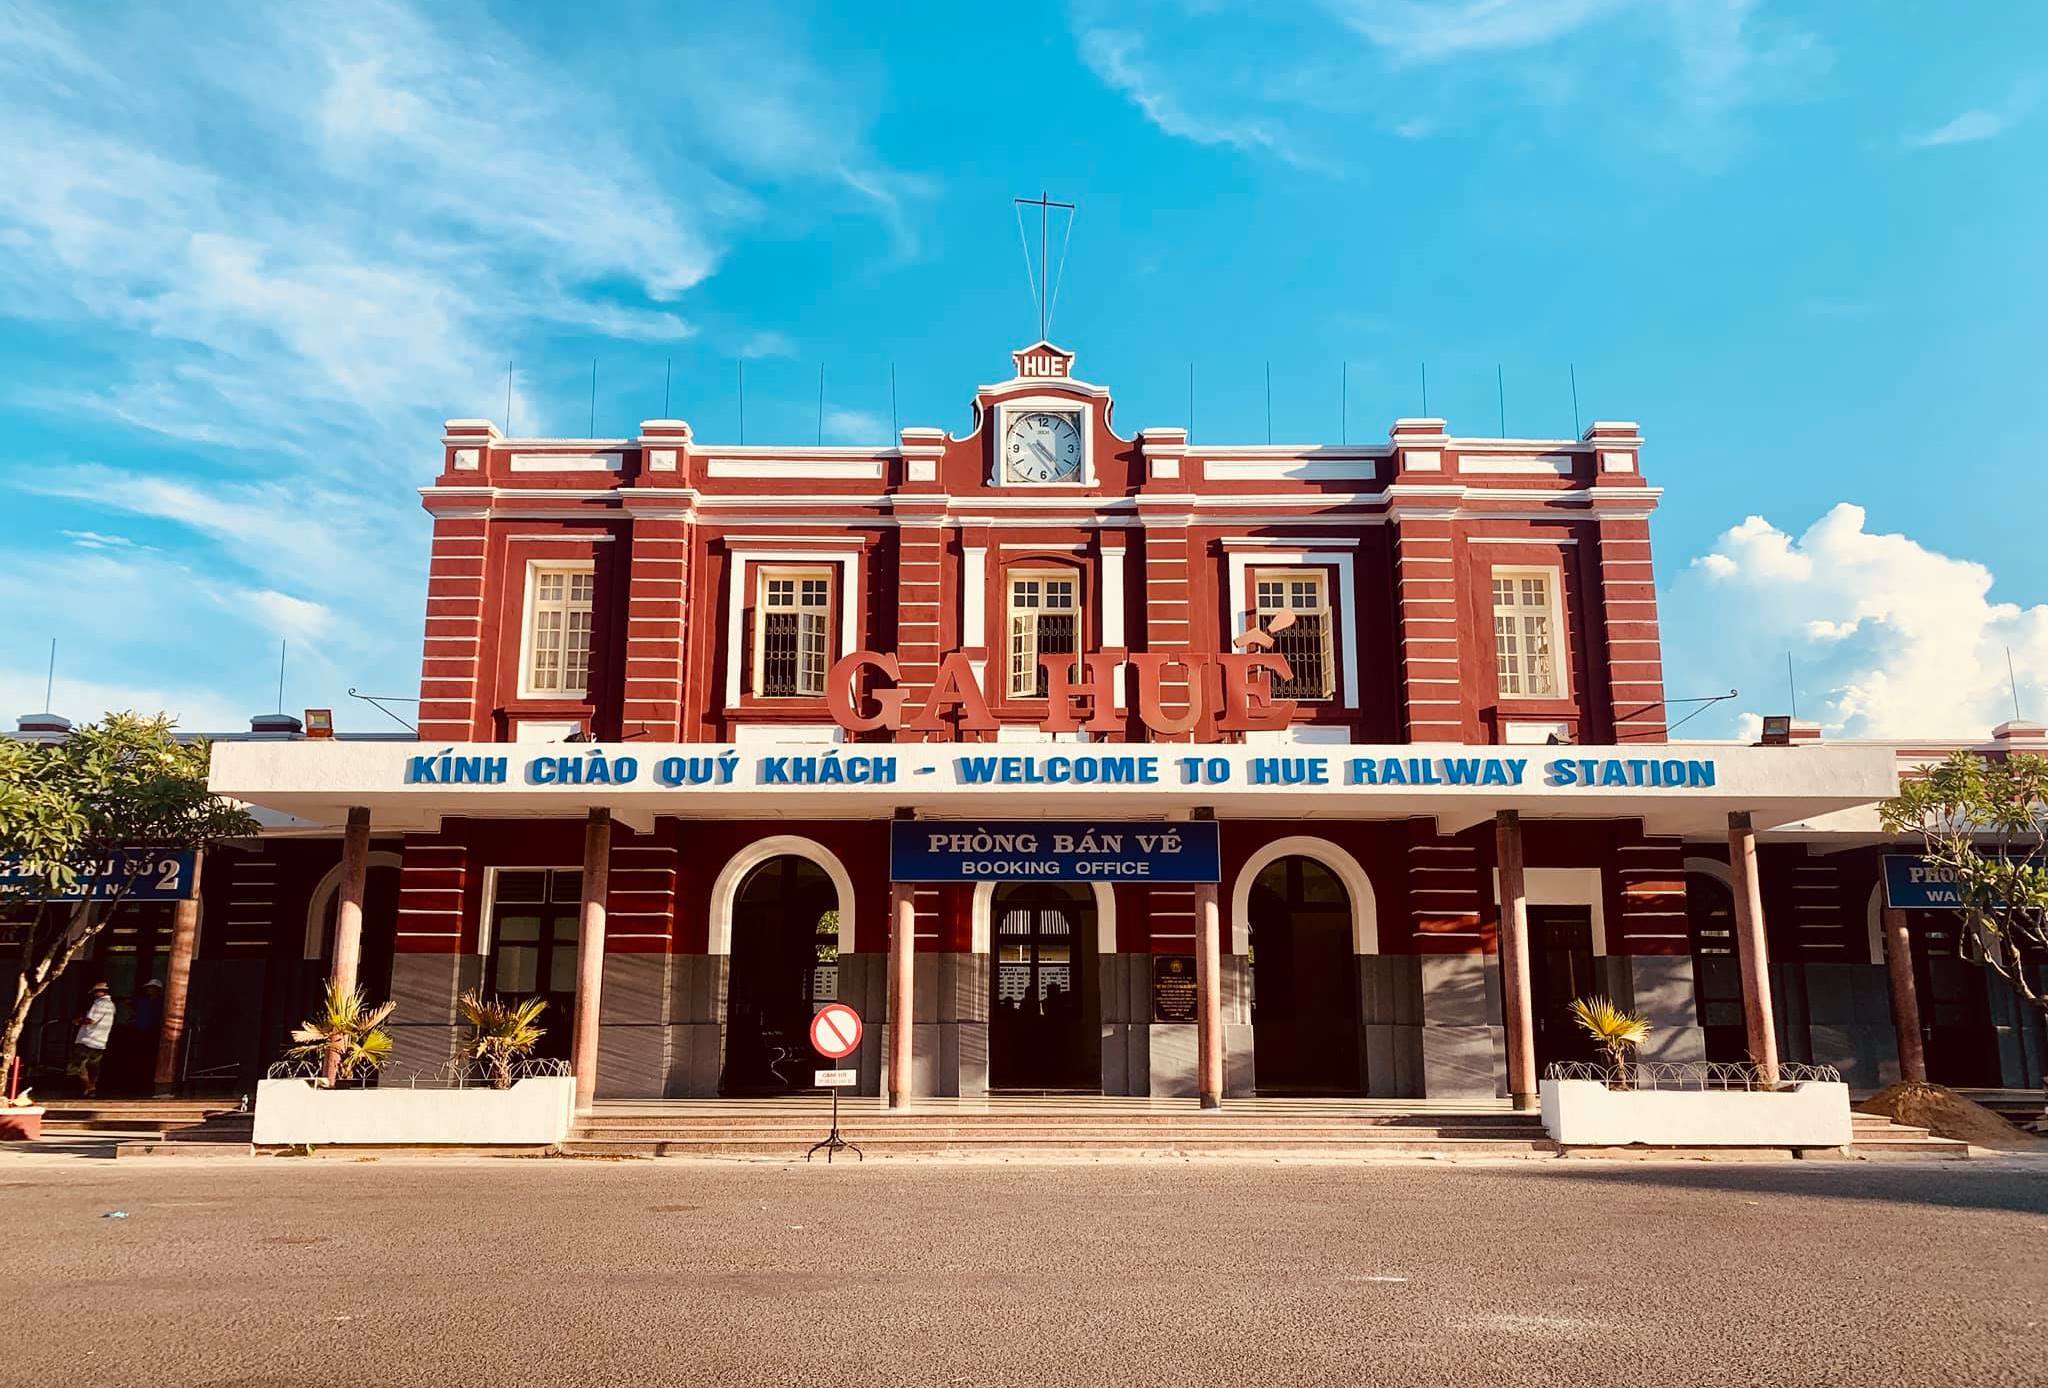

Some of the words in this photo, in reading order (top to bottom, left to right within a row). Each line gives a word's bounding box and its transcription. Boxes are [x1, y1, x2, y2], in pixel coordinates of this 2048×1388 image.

[1023, 356, 1064, 376] HUE
[1038, 417, 1049, 427] 12
[1013, 444, 1020, 453] 9
[1067, 444, 1074, 453] 3
[1040, 471, 1047, 480] 6
[828, 650, 1001, 732] GA
[1039, 609, 1297, 733] HUẾ
[412, 748, 507, 784] KÍNH
[531, 749, 638, 785] CHÀO
[661, 750, 740, 787] QUÝ
[764, 750, 897, 784] KHÁCH
[960, 757, 1159, 784] WELCOME
[1183, 758, 1230, 784] TO
[1255, 758, 1329, 784] HUE
[1353, 758, 1528, 786] RAILWAY
[1553, 759, 1716, 787] STATION
[928, 827, 1039, 854] PHÒNG
[1053, 828, 1123, 854] BÁN
[1135, 828, 1183, 854] VÉ
[155, 860, 180, 890] 2
[962, 861, 1060, 875] BOOKING
[1075, 861, 1150, 875] OFFICE
